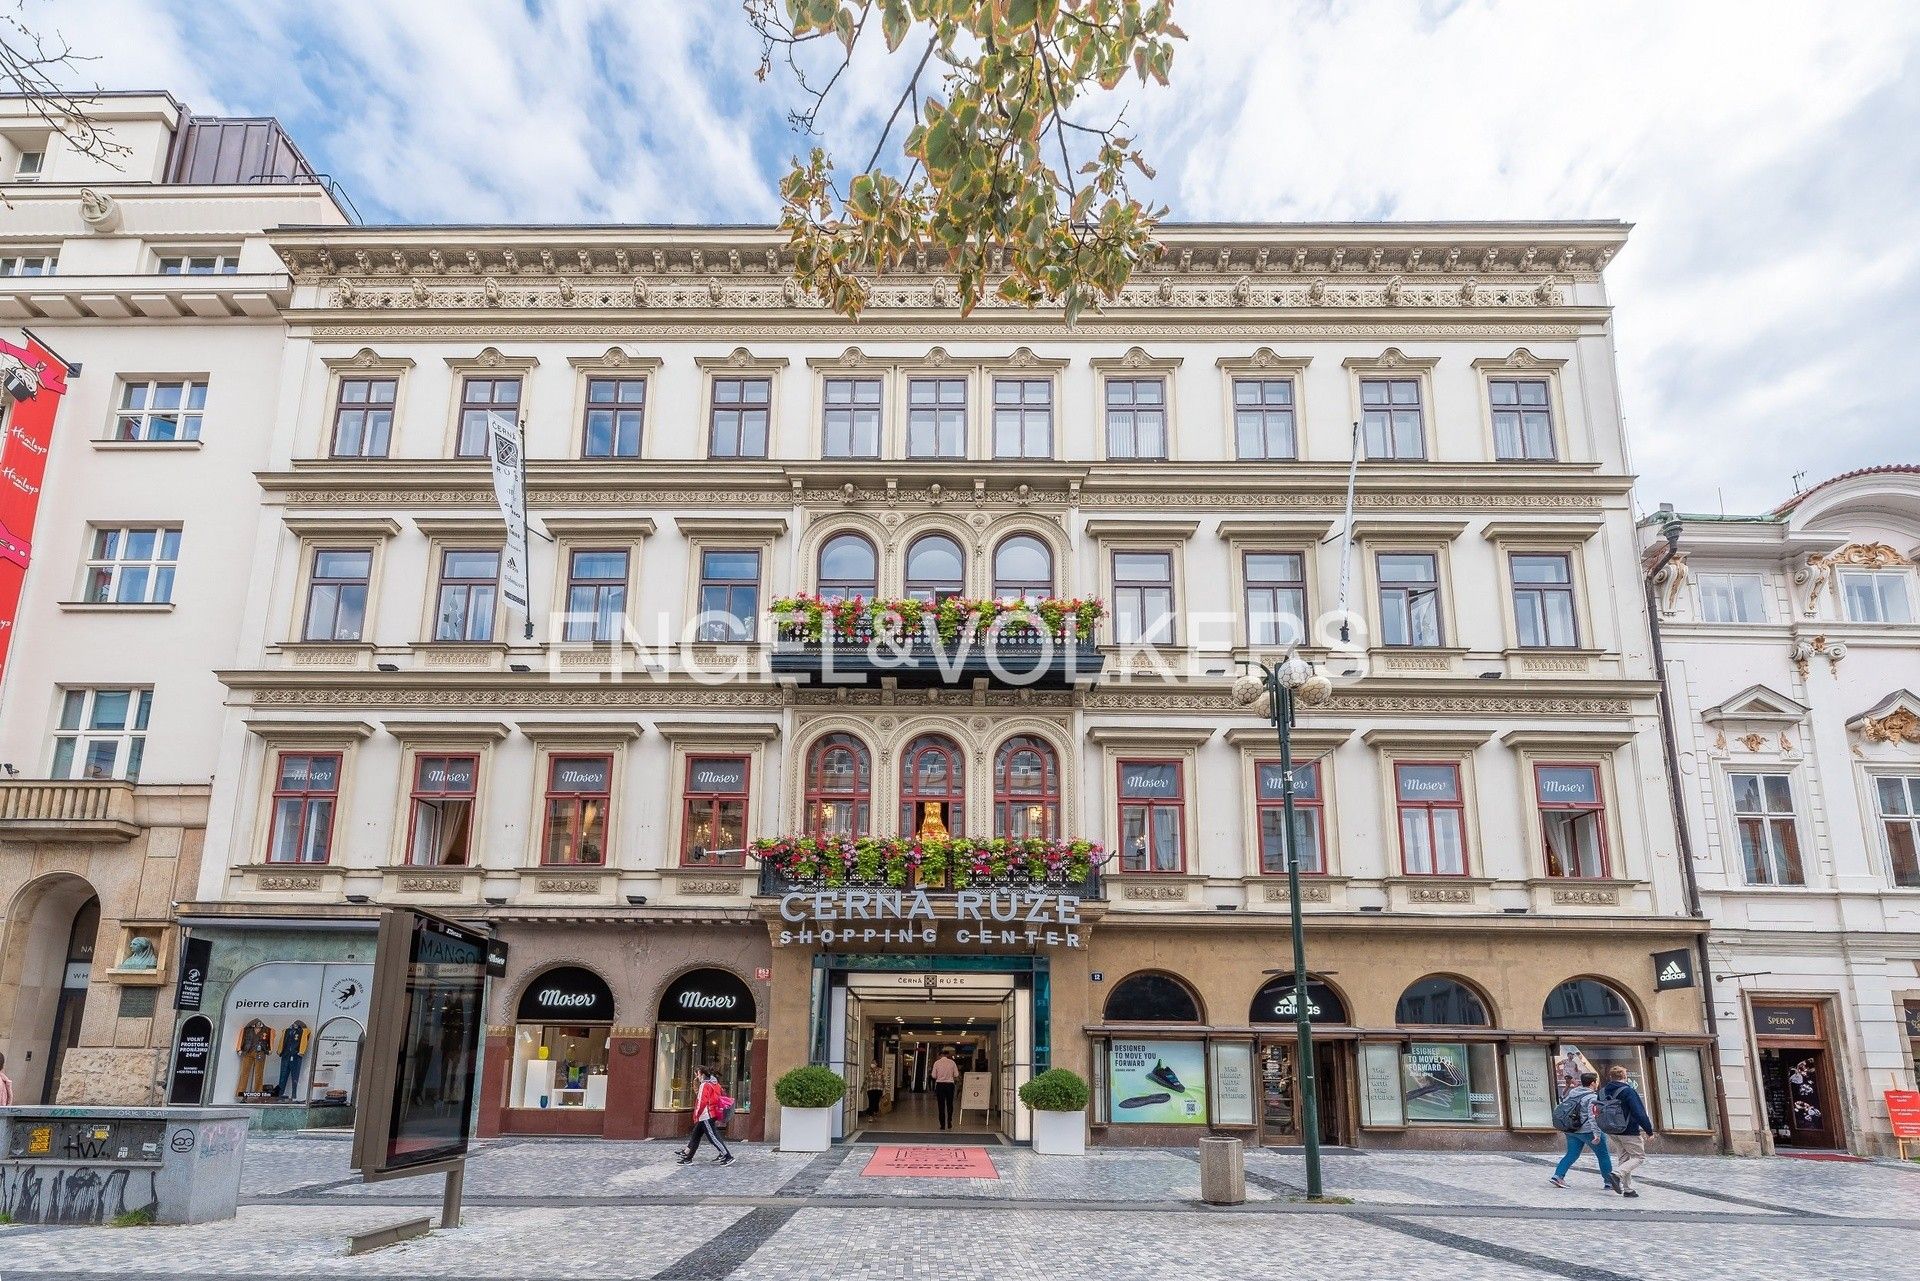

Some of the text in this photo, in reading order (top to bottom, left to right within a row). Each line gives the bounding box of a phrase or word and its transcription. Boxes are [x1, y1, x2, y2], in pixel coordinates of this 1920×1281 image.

[12, 425, 48, 455] Hamleys
[2, 466, 39, 495] Hamleys
[428, 770, 469, 782] Moser
[561, 770, 602, 783] Moser
[697, 771, 739, 783] Moser
[1127, 776, 1169, 788] Moser
[1266, 777, 1308, 789] Mer
[1404, 778, 1447, 791] Moser
[1543, 780, 1585, 793] Moser
[780, 884, 1081, 924] ČERNÁ RŮŽE
[780, 928, 1080, 947] SHOPPING CENTER
[1660, 972, 1687, 982] adidas
[236, 999, 309, 1009] pierre cardin
[538, 989, 597, 1007] Moser
[678, 991, 737, 1009] Moser
[1767, 1016, 1796, 1025] ŠPERKY
[1412, 1047, 1441, 1055] ESIGNED
[1408, 1063, 1442, 1071] FORWARD
